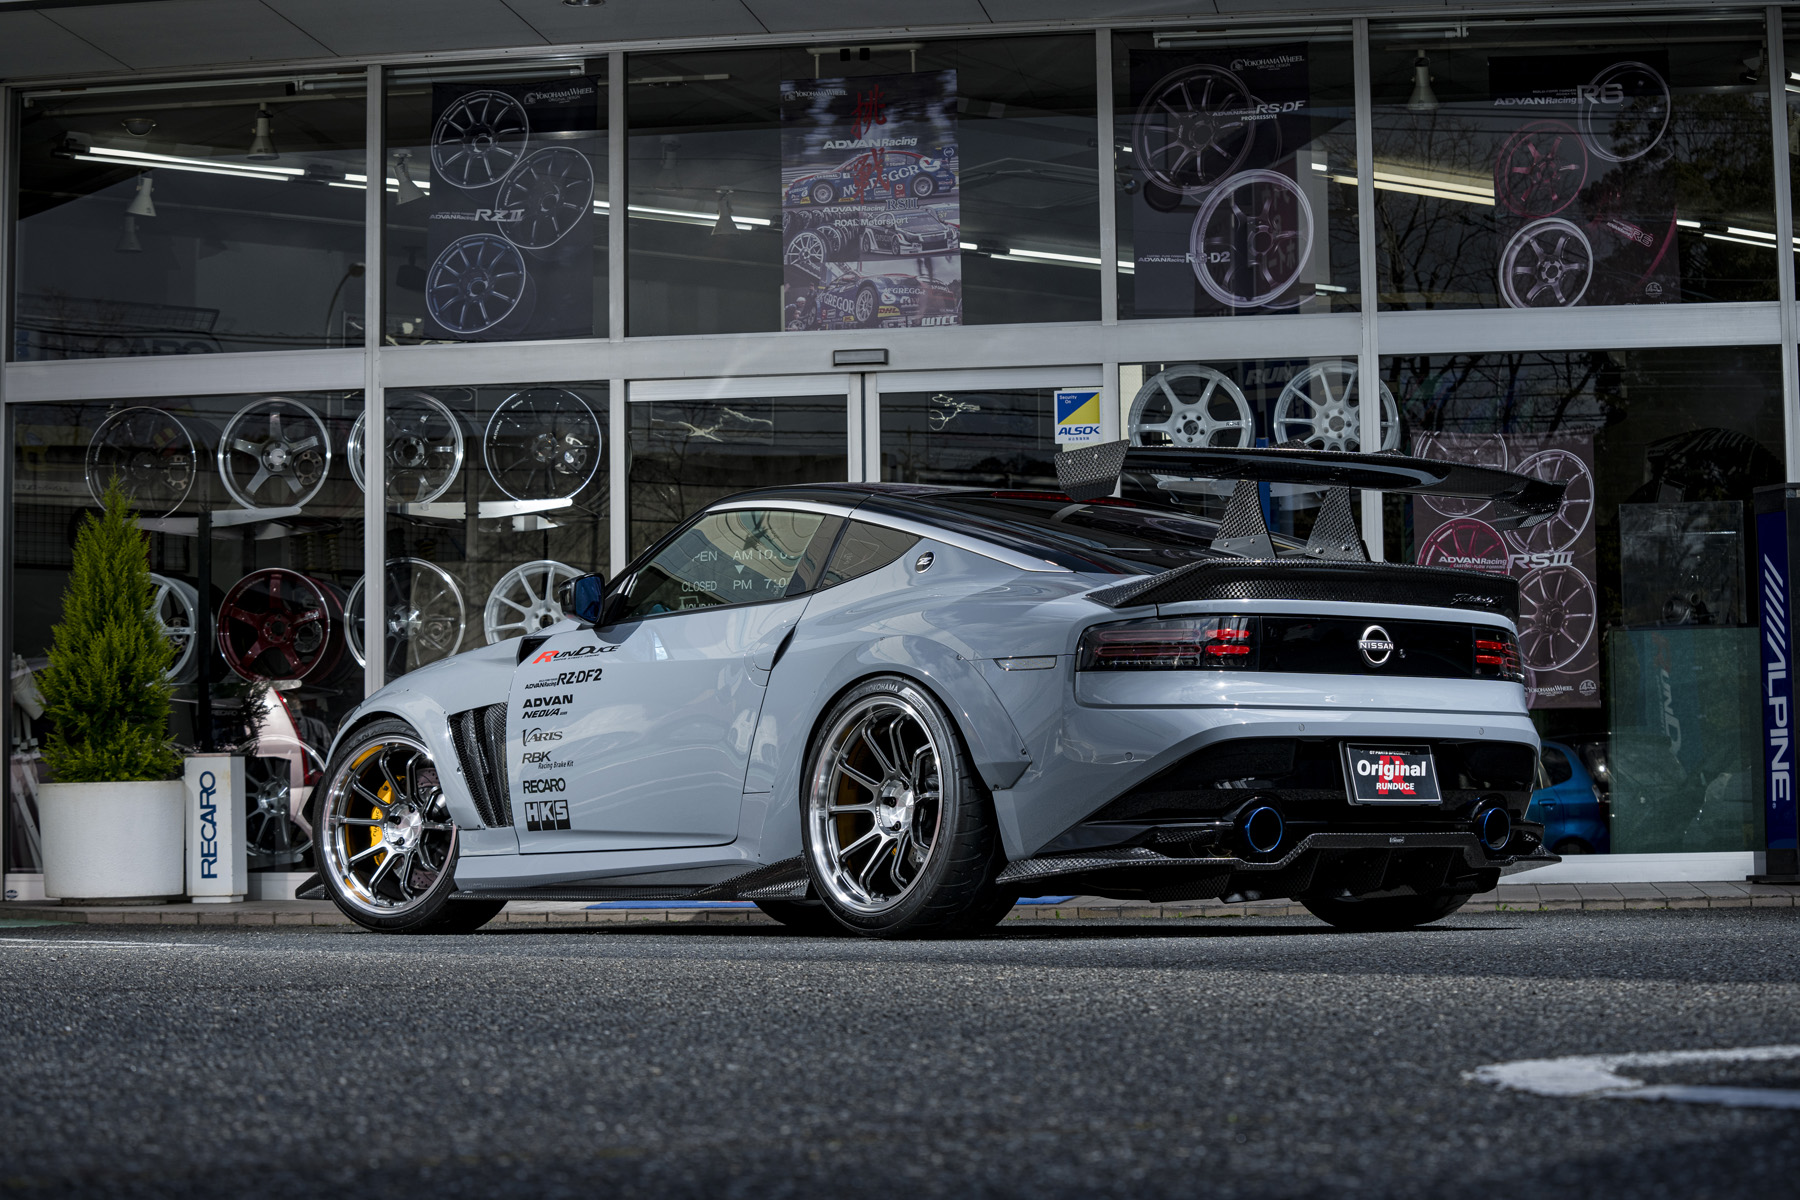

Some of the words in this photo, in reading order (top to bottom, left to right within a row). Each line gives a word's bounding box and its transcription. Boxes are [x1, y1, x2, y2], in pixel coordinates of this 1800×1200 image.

[1576, 84, 1625, 105] R6
[1058, 426, 1101, 436] ALSOK
[682, 580, 718, 593] CLOSED
[733, 579, 753, 590] PM
[1359, 642, 1394, 650] NISSAN
[523, 694, 573, 709] ADVAN
[522, 708, 561, 719] NEOVA
[1766, 632, 1791, 803] ALPINE
[522, 750, 552, 764] RBK
[538, 762, 553, 771] Racing
[554, 761, 566, 769] Brake
[1356, 759, 1428, 781] Original
[523, 778, 566, 794] RECARO
[1376, 782, 1415, 791] RUNDUCE
[525, 800, 571, 827] HKS
[199, 770, 218, 879] RECARO
